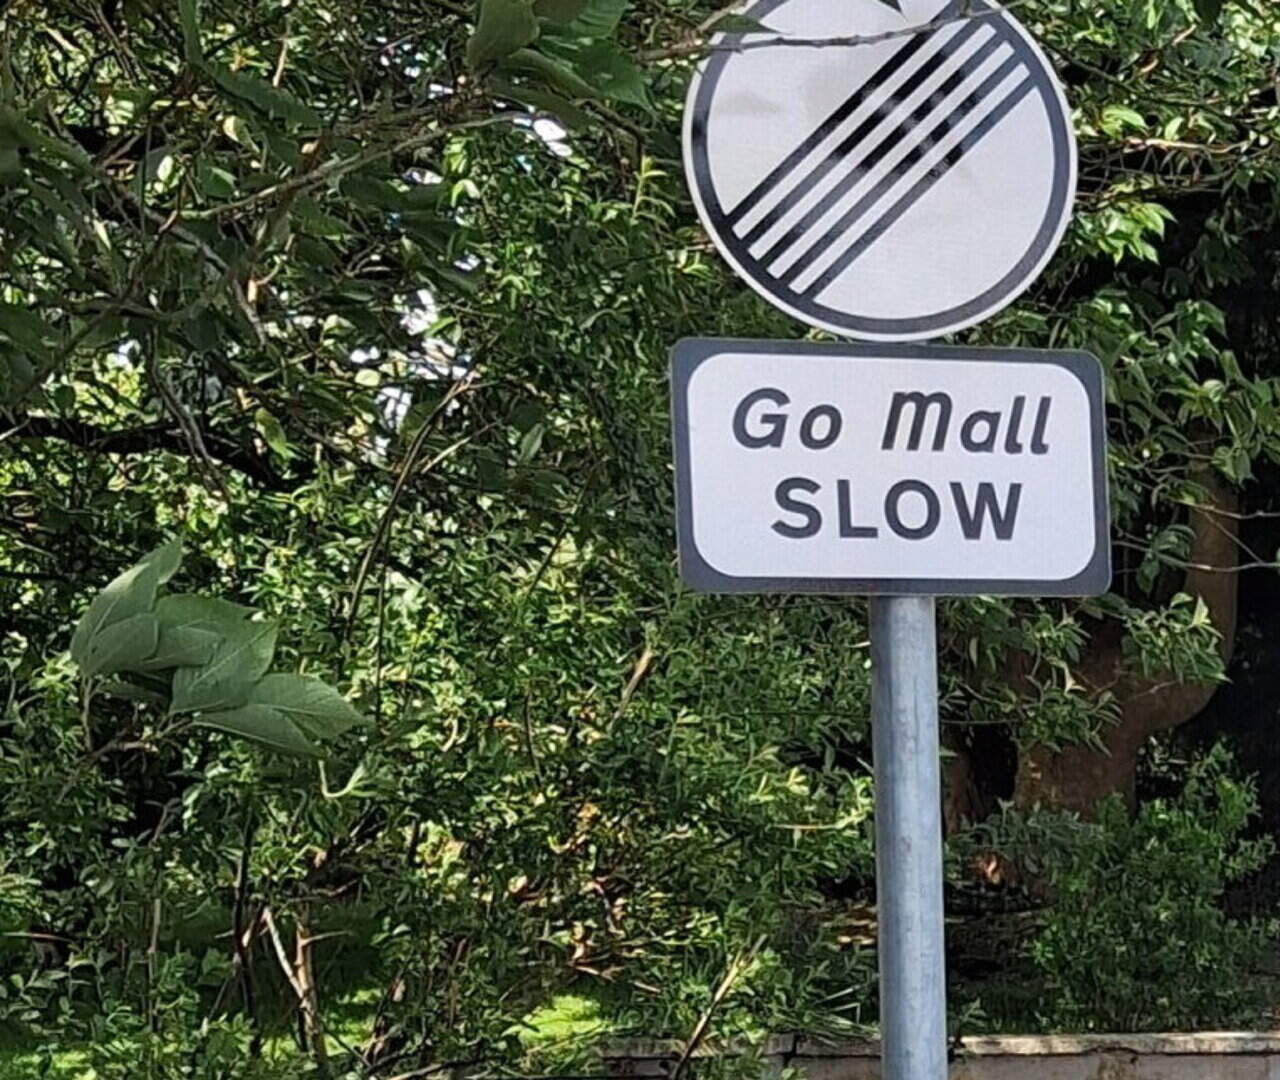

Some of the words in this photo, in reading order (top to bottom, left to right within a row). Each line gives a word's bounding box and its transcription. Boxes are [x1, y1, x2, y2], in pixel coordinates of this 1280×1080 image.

[733, 387, 843, 450] Go
[881, 390, 1052, 455] Mall
[771, 477, 1022, 541] SLOW
